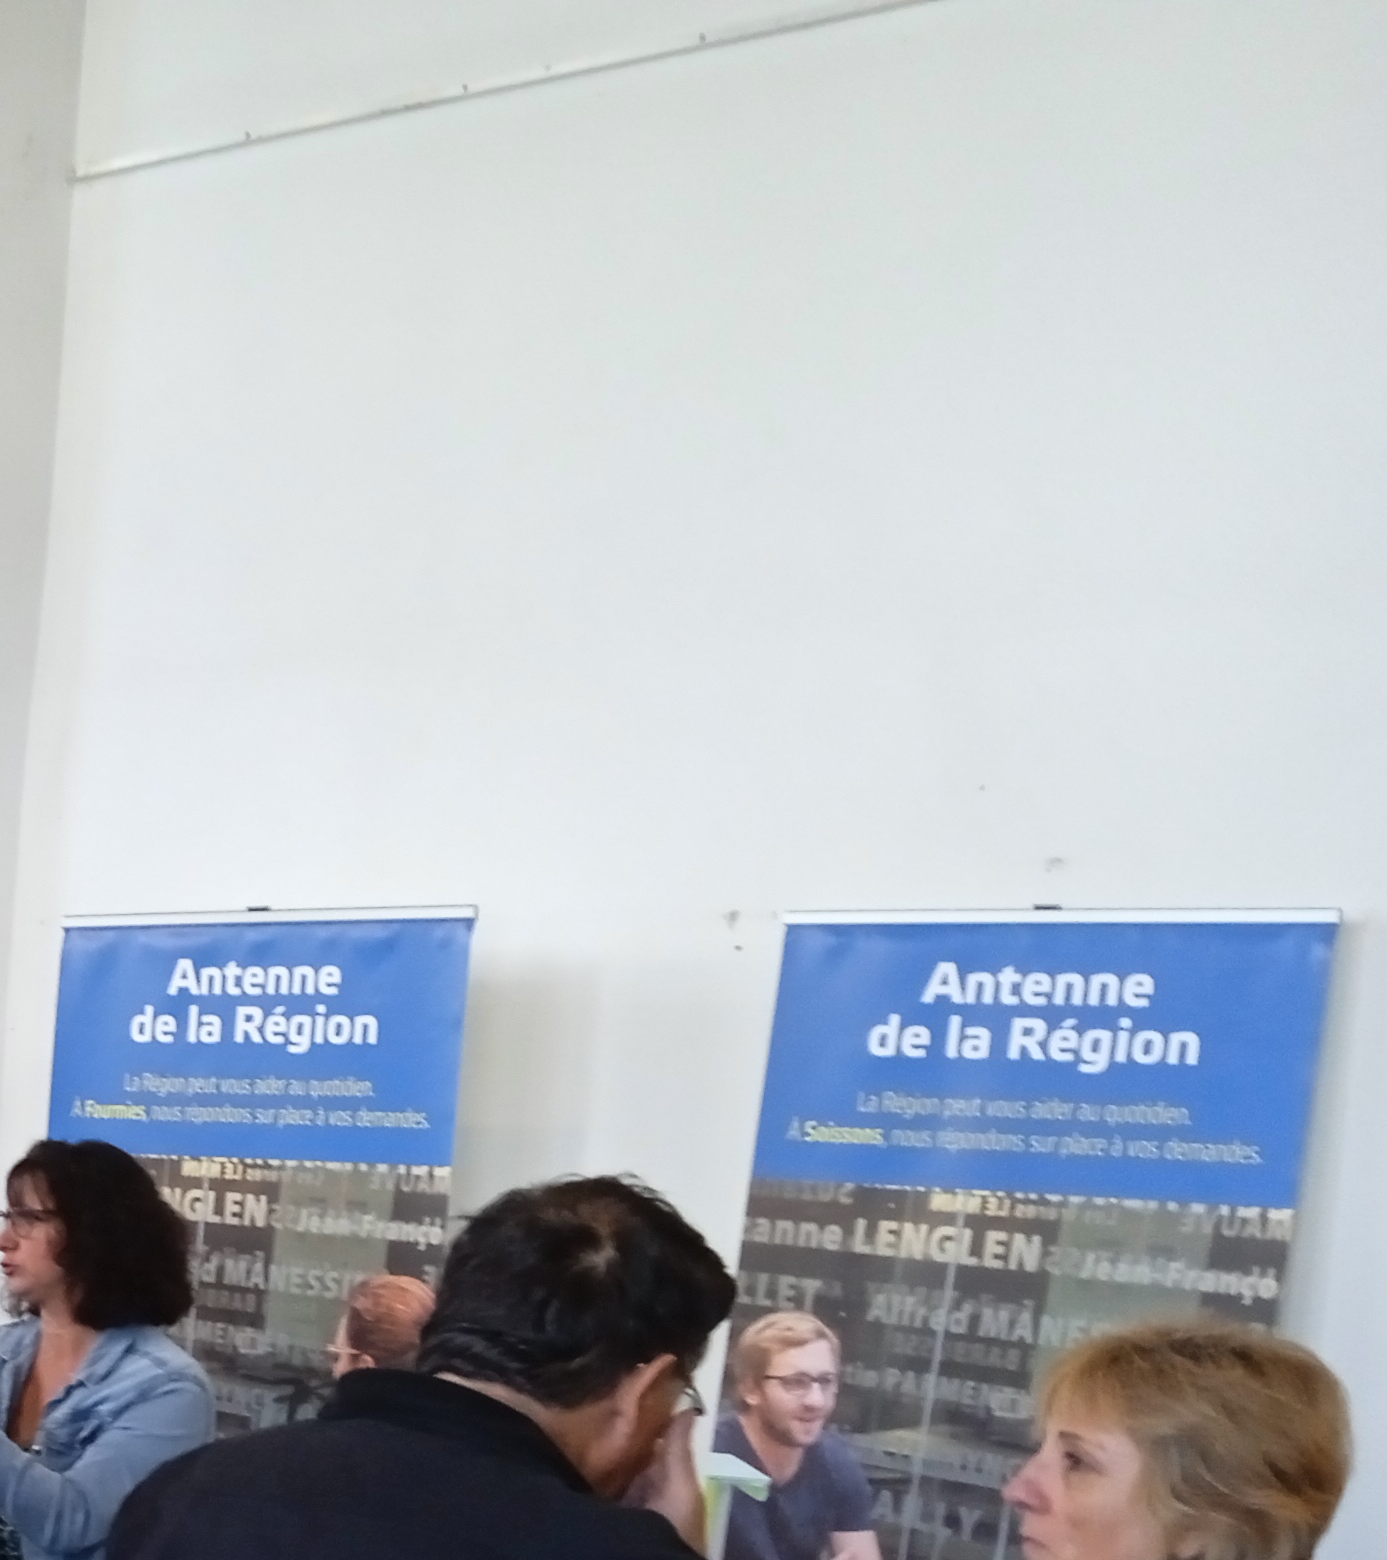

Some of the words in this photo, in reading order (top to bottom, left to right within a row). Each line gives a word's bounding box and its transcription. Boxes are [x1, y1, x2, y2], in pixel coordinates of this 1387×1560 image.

[167, 958, 342, 997] Antenne
[922, 962, 1155, 1007] Antenne
[130, 1005, 177, 1044] de
[187, 1007, 222, 1044] la
[233, 1005, 379, 1054] Région
[867, 1014, 931, 1059] de
[946, 1017, 990, 1060] la
[1007, 1018, 1200, 1073] Région
[123, 1073, 140, 1092] La
[142, 1072, 186, 1097] Région
[186, 1076, 218, 1097] peut
[219, 1078, 252, 1095] vous
[253, 1075, 287, 1096] aider
[287, 1079, 307, 1096] au
[308, 1076, 375, 1100] quotidien.
[150, 1105, 182, 1122] nous
[184, 1103, 253, 1125] répondons
[254, 1108, 276, 1124] sur
[277, 1105, 314, 1129] place
[314, 1106, 326, 1127] à
[328, 1110, 353, 1127] vos
[354, 1107, 431, 1129] demandes.
[857, 1092, 878, 1112] La
[881, 1091, 940, 1119] Région
[942, 1097, 980, 1119] peut
[985, 1100, 1026, 1118] vous
[1028, 1098, 1074, 1120] aider
[1077, 1103, 1101, 1121] au
[1103, 1101, 1192, 1126] quotidien.
[890, 1129, 933, 1147] nous
[936, 1127, 1026, 1153] répondons
[1028, 1134, 1058, 1153] sur
[1058, 1132, 1108, 1158] place
[1110, 1134, 1123, 1157] à
[1126, 1140, 1161, 1159] vos
[1162, 1137, 1264, 1165] demandes.
[853, 1217, 1043, 1273] LENGLEN
